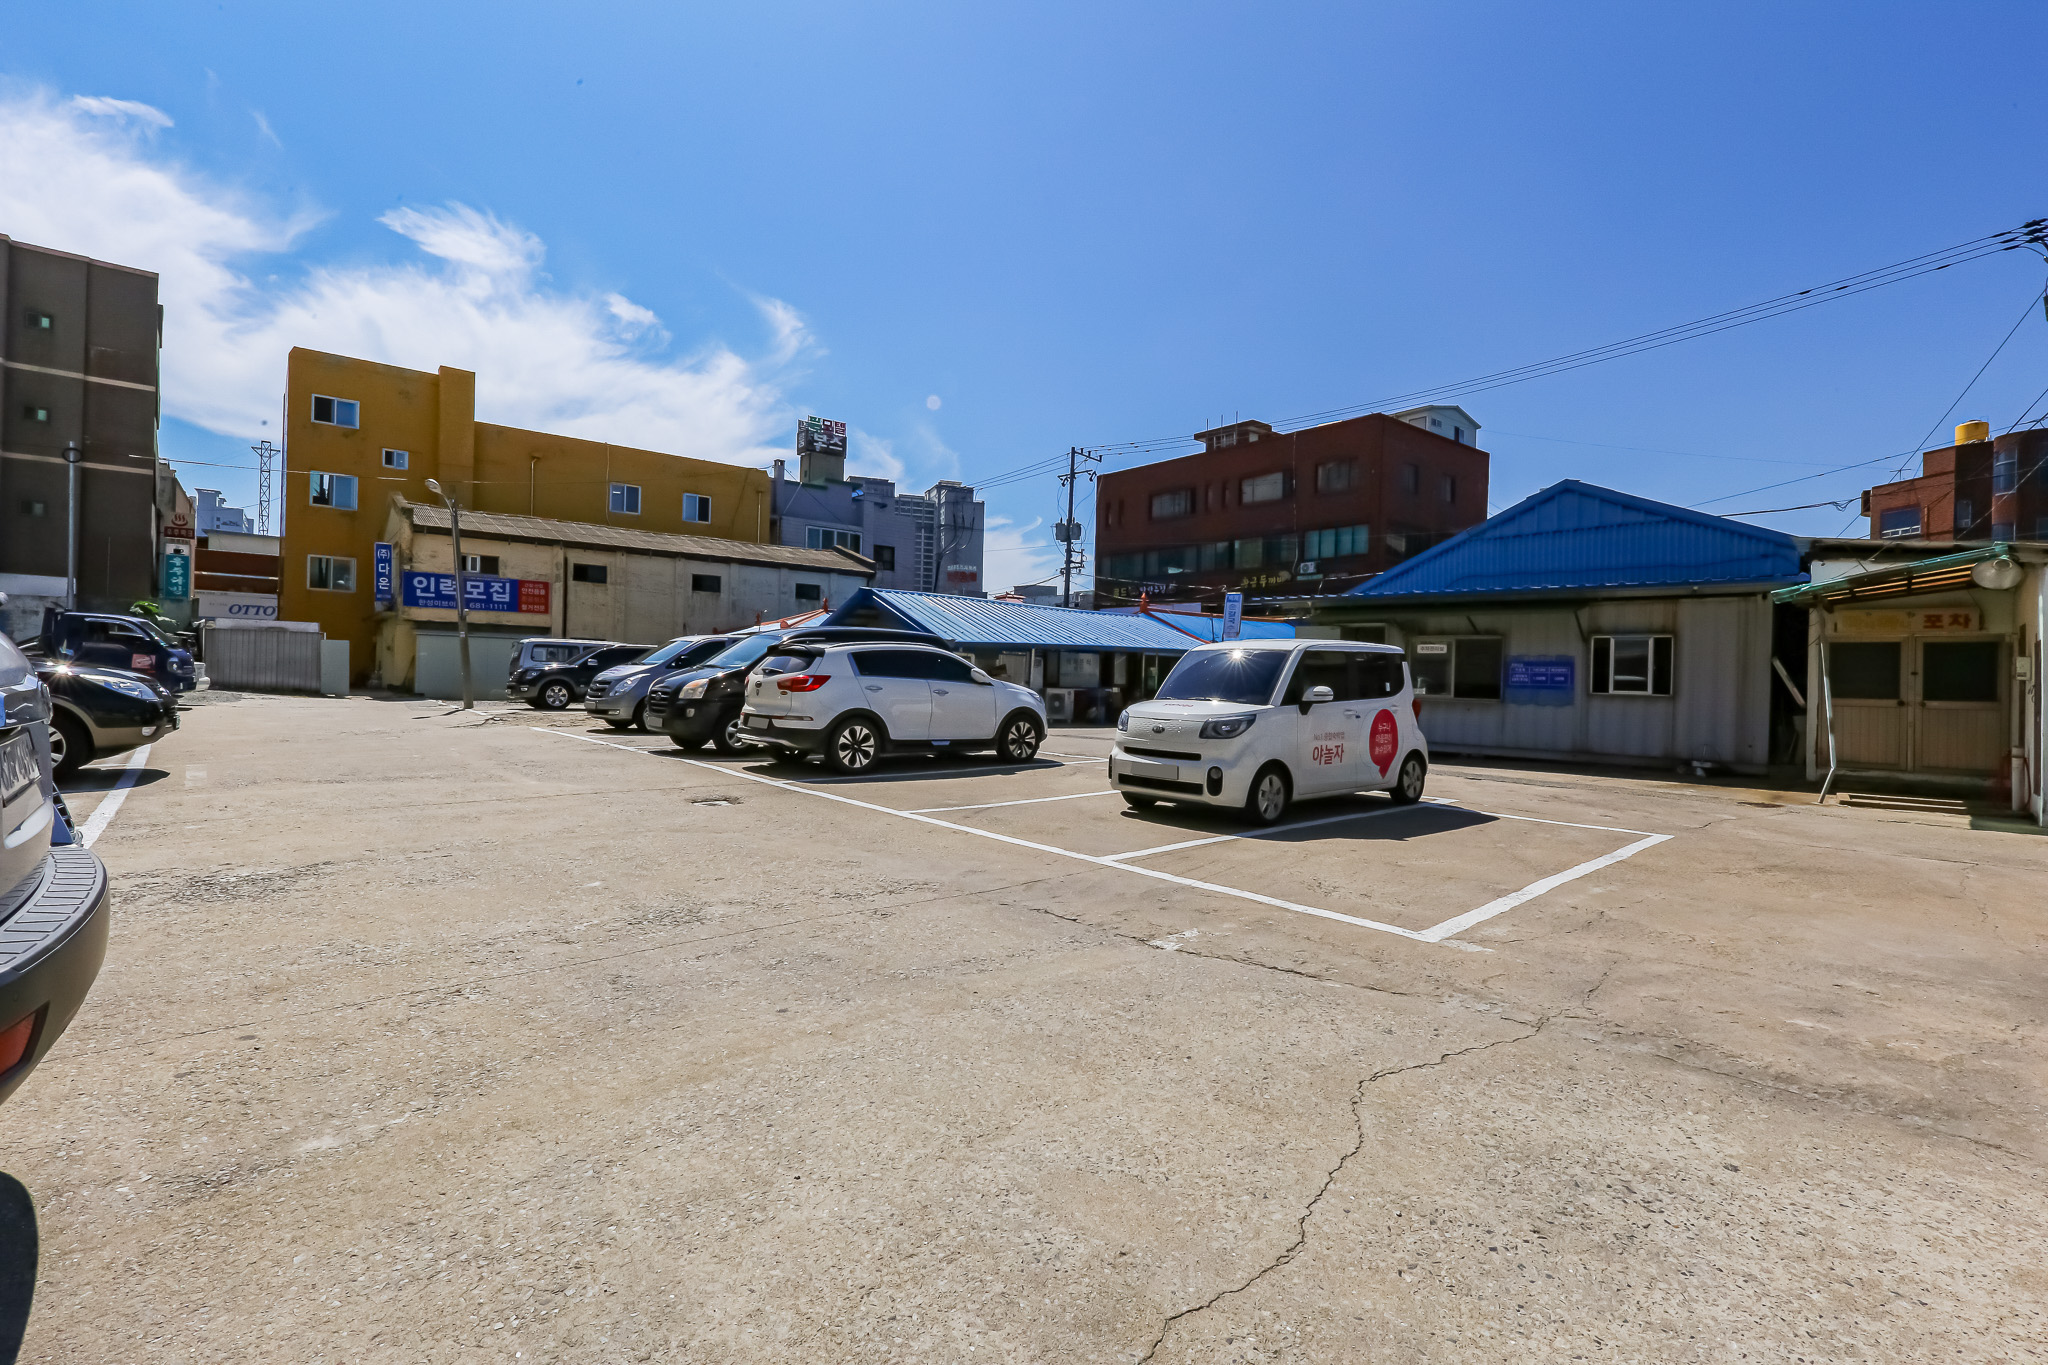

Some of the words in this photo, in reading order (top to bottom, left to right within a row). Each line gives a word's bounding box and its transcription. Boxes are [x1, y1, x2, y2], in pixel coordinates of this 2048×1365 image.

[469, 602, 508, 610] 681-1111
[1378, 722, 1392, 732] 누구나
[1312, 742, 1345, 766] 야놀자
